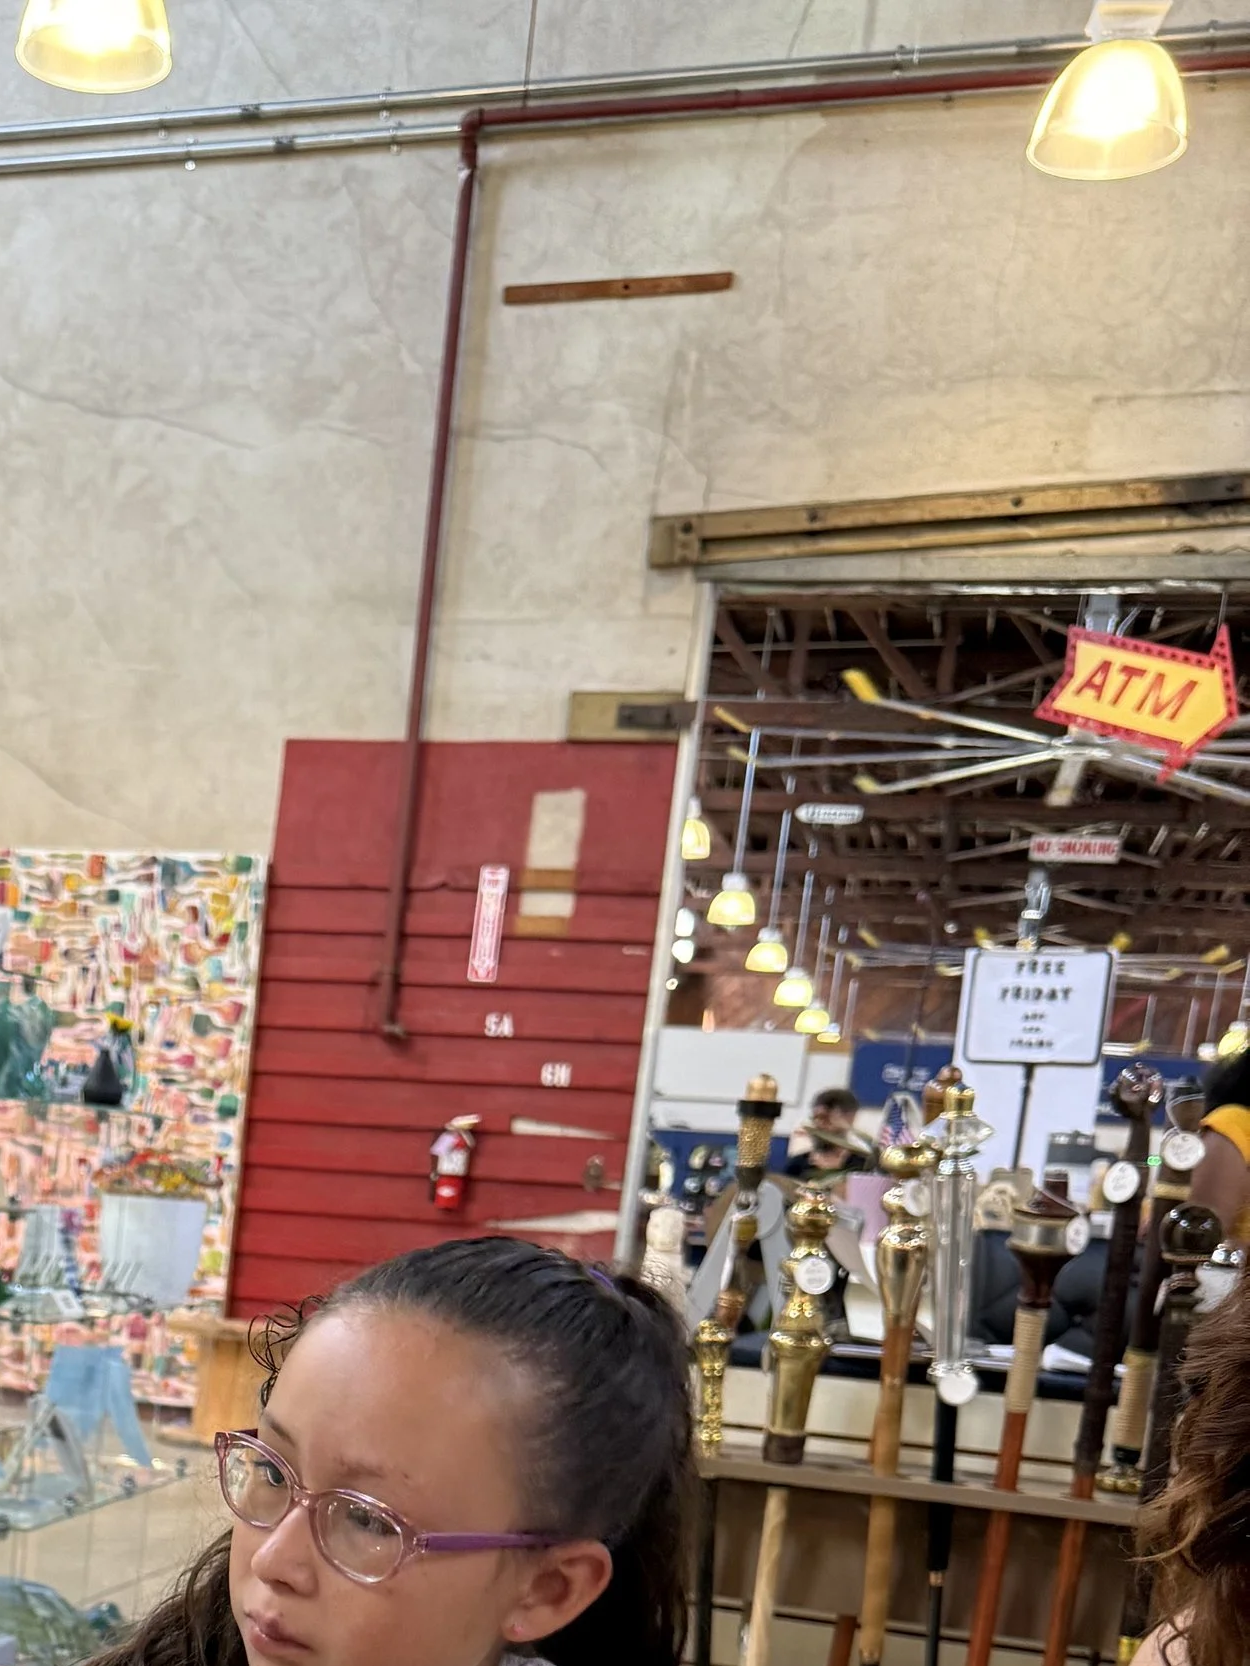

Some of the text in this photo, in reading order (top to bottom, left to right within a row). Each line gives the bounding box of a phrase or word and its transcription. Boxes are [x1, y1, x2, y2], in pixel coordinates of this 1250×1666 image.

[1074, 660, 1198, 721] ATM
[1015, 960, 1066, 975] FREE
[999, 986, 1073, 1002] FRIDAY
